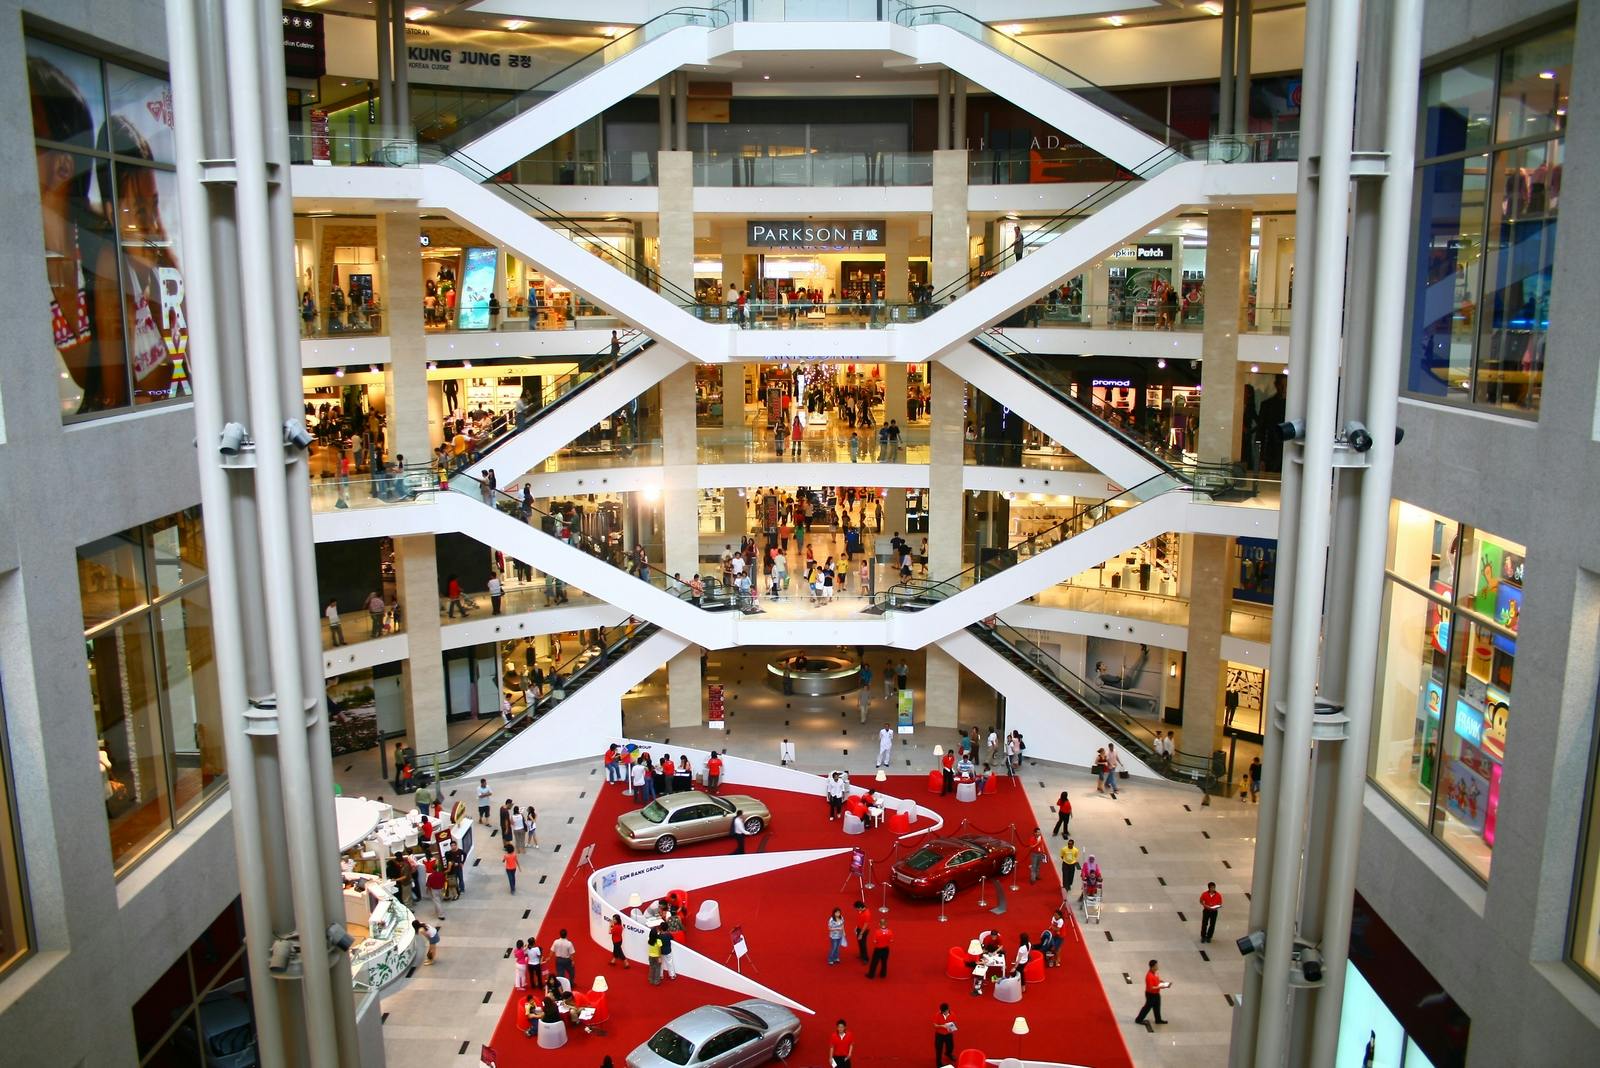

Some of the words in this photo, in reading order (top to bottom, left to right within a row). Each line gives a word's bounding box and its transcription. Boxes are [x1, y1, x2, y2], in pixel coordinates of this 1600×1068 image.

[408, 47, 452, 62] KUNG
[460, 51, 501, 66] JUNG
[508, 55, 532, 68] 궁정
[753, 226, 846, 241] PARKSON
[851, 229, 879, 241] 百盛
[1137, 247, 1164, 257] Patch
[1092, 379, 1131, 387] promod
[630, 869, 645, 877] BANK
[645, 864, 665, 873] GROUP
[626, 925, 645, 934] GROUP
